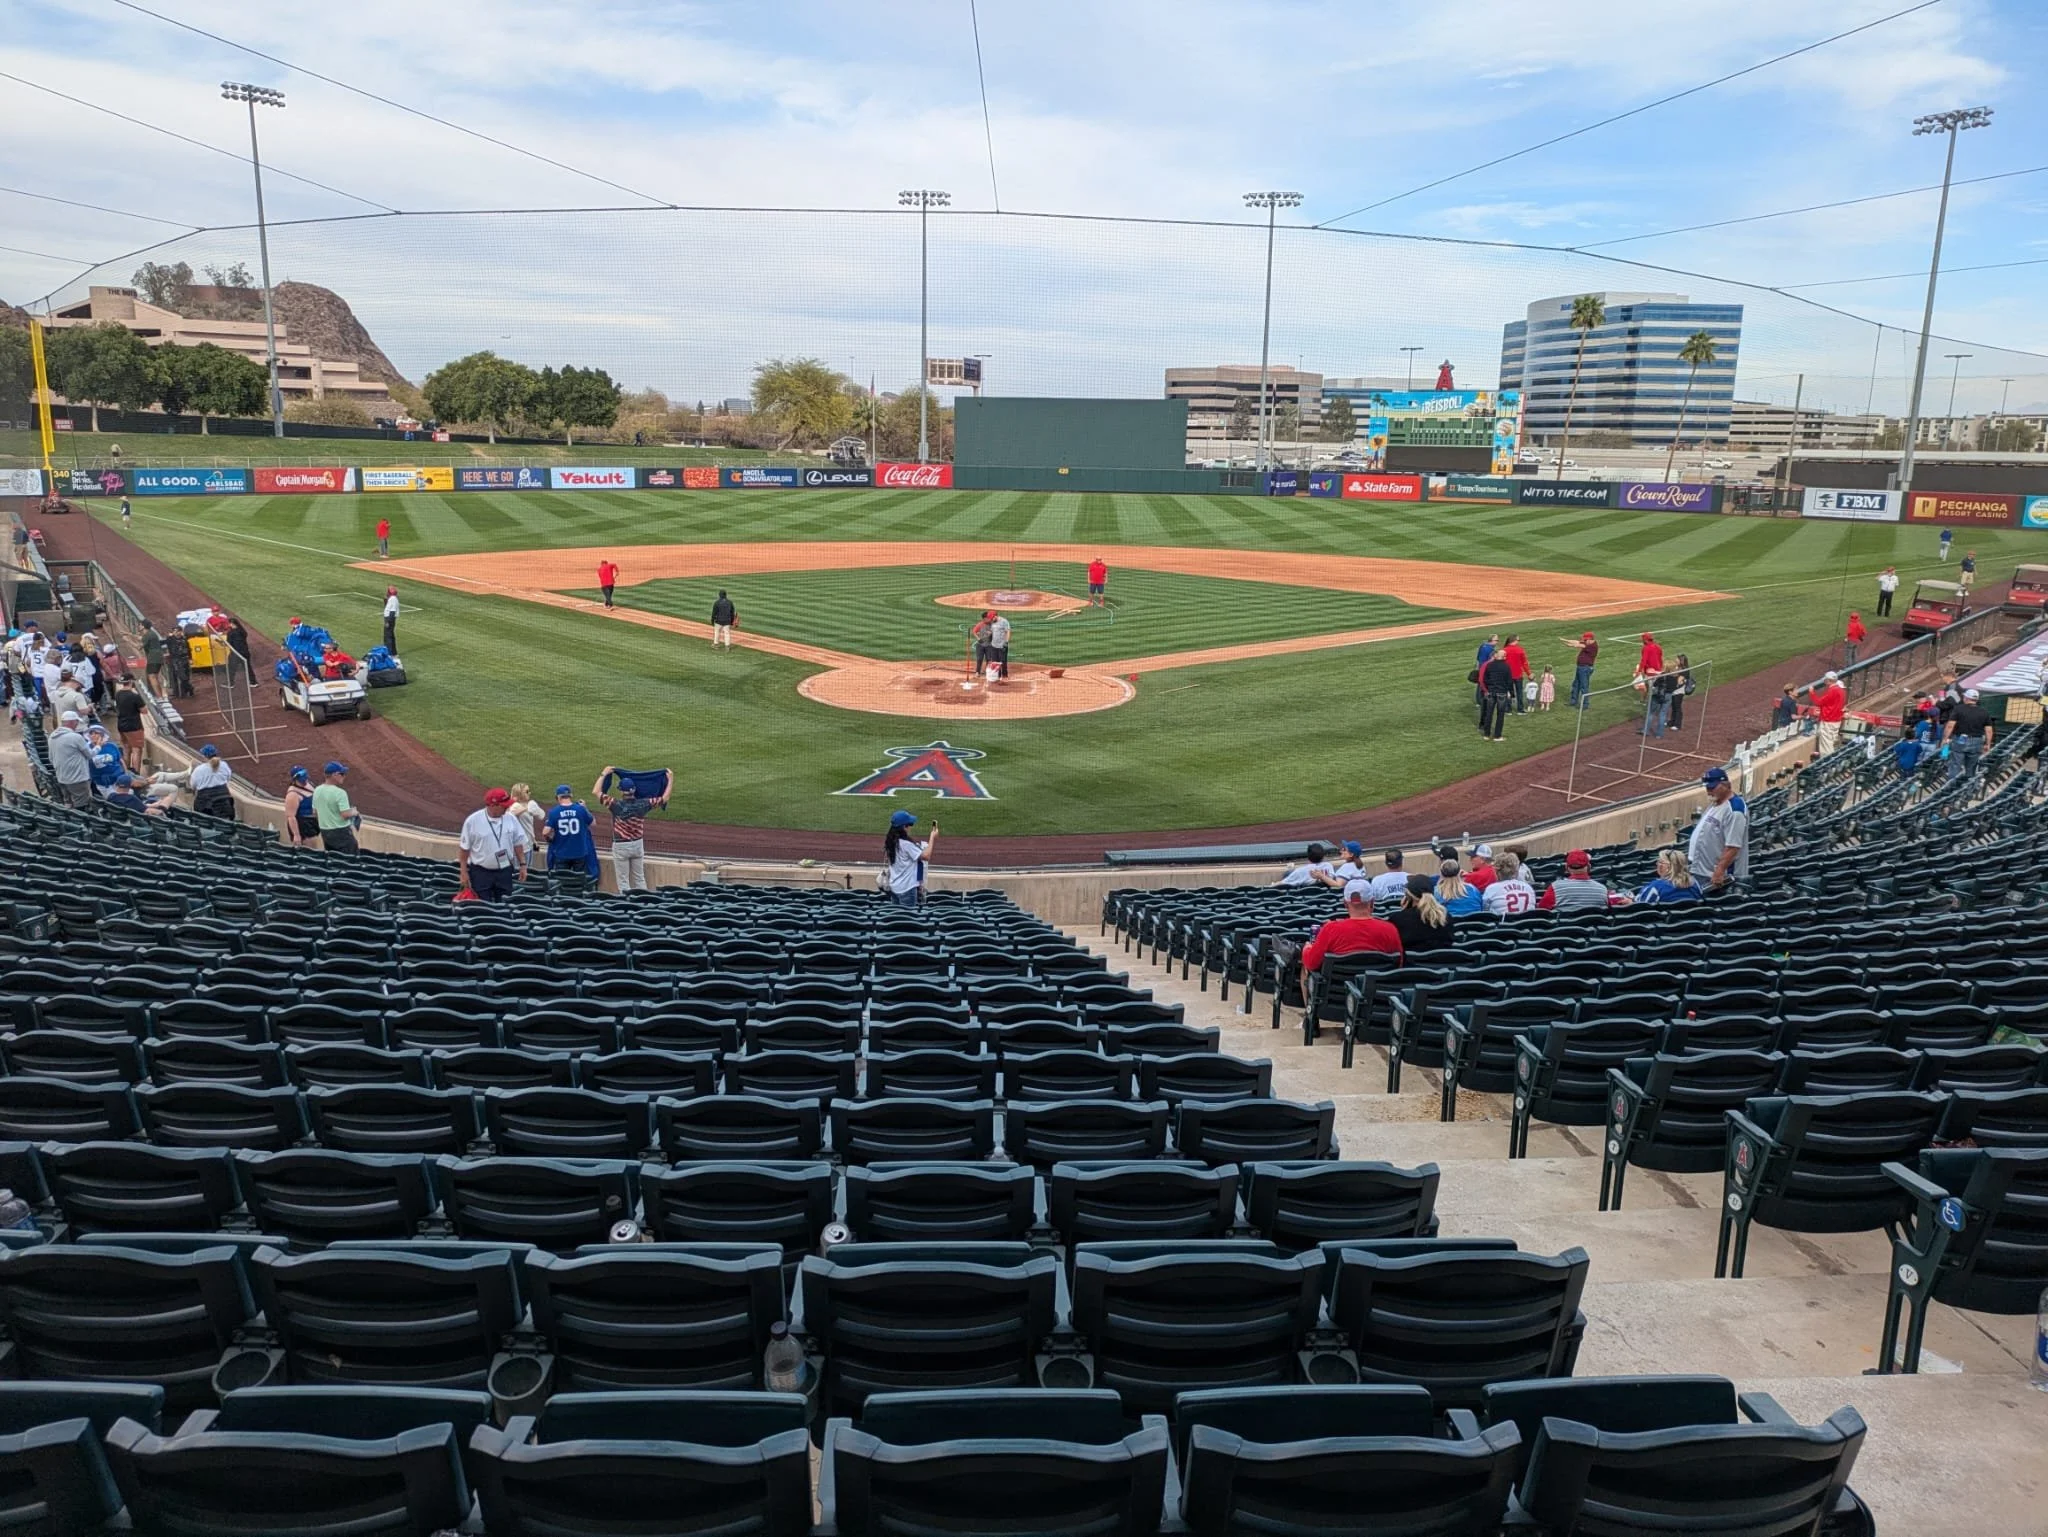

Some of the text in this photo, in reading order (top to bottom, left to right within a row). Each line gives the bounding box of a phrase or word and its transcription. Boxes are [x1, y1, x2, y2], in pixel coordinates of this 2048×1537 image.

[53, 470, 69, 478] 340
[275, 474, 327, 486] Captain Morgan
[463, 471, 483, 482] HERE
[485, 471, 499, 482] WE
[501, 471, 514, 482] GO!
[560, 473, 625, 484] Yakult
[823, 474, 869, 482] LEXUS
[884, 465, 942, 486] Coca-Cola
[138, 477, 200, 486] ALL GOOD.
[1523, 487, 1608, 500] NITTO TIRE.COM
[1627, 484, 1705, 508] Crown Royal
[1841, 495, 1881, 508] FBM
[1939, 500, 2008, 513] PECHANGA
[1939, 510, 2008, 519] RESORT CASINO
[560, 809, 577, 818] BETTS
[558, 818, 580, 836] 50
[1506, 893, 1529, 912] 27
